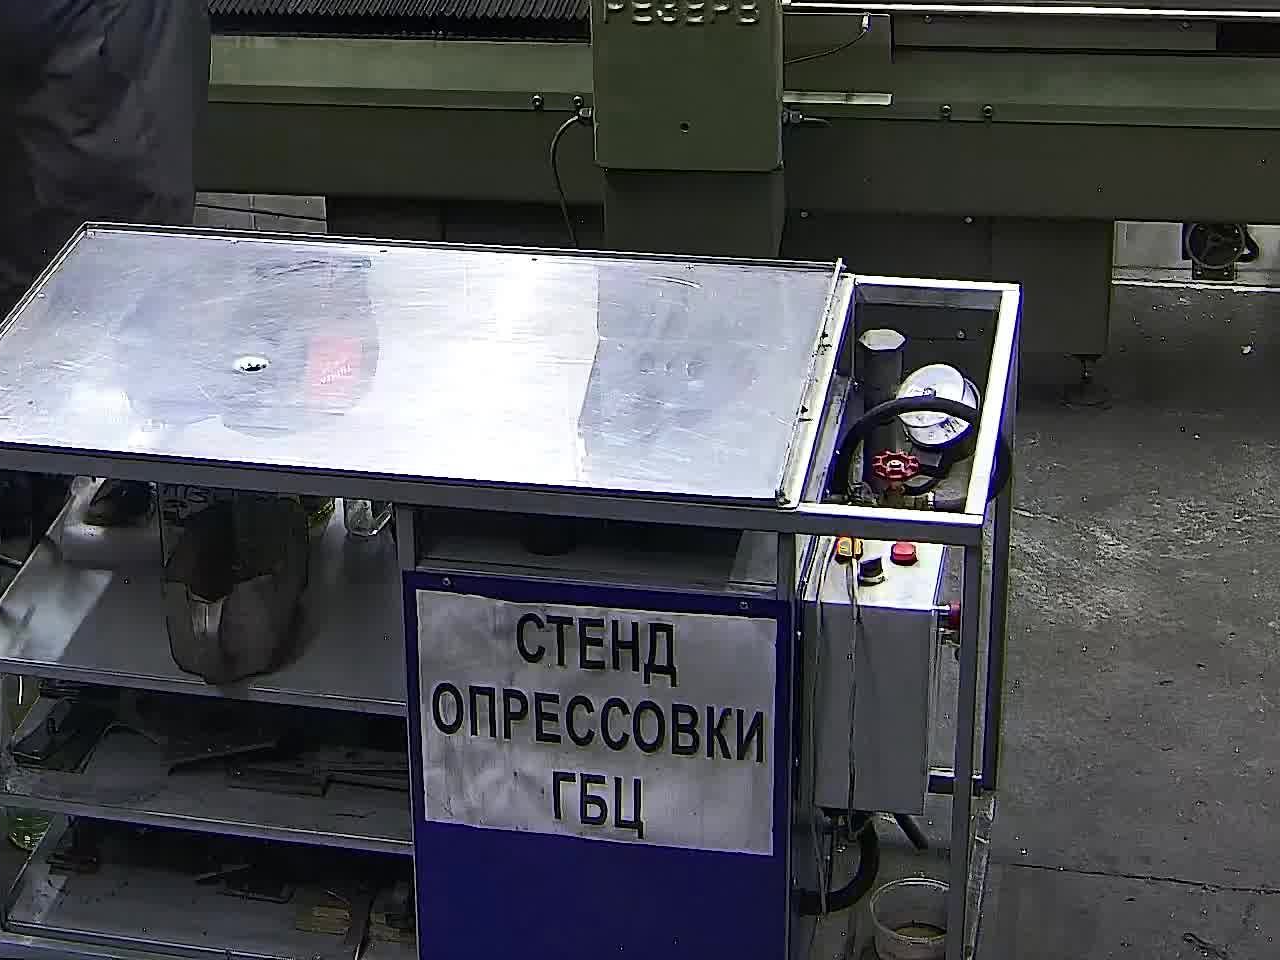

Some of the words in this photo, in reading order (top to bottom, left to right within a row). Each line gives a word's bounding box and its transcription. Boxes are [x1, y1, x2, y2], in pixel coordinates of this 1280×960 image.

[516, 612, 679, 688] СТЕНД
[432, 682, 765, 763] ОПРЕССОВКИ
[552, 770, 646, 839] ГБЦ
